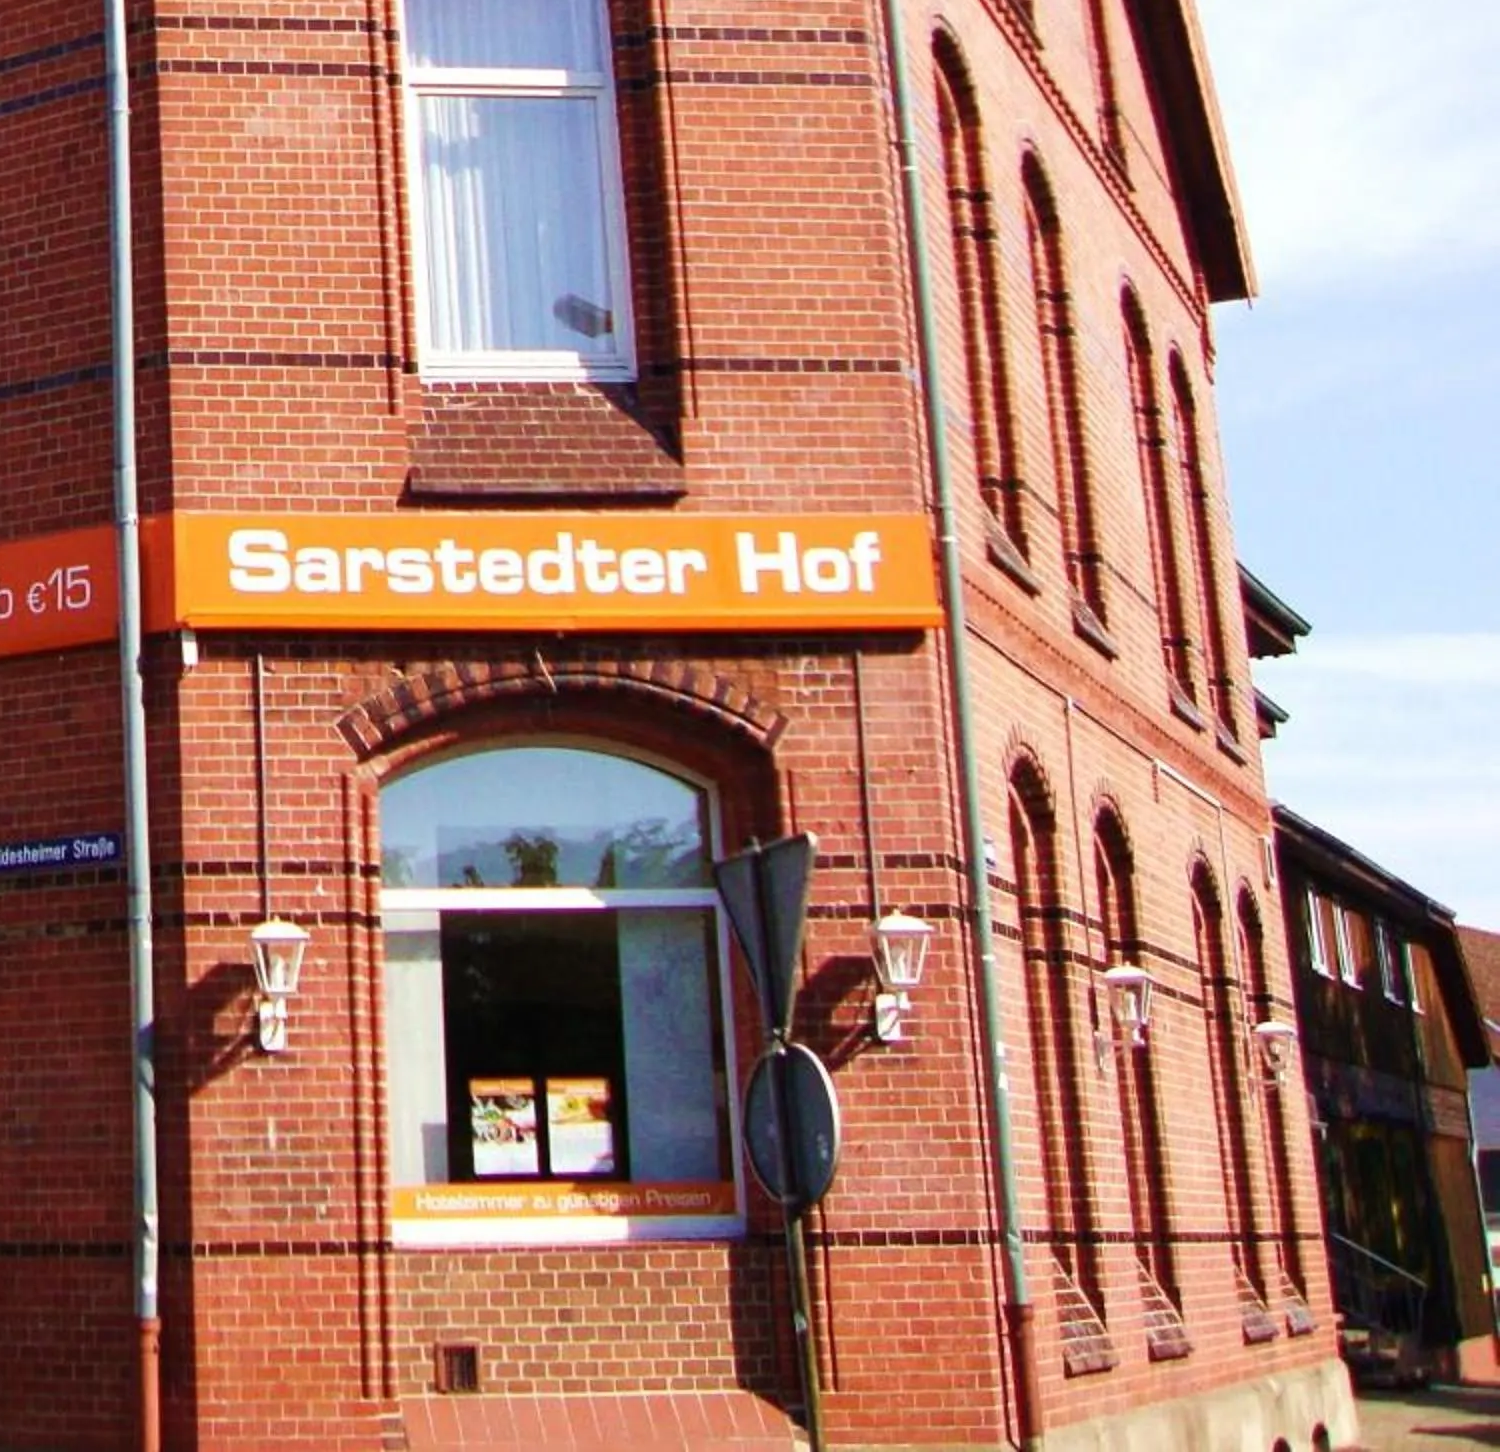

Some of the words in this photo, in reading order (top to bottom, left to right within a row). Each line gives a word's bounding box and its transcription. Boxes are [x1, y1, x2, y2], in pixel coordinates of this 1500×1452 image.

[228, 529, 708, 595] Sarstedter
[735, 531, 882, 594] Hof
[26, 564, 92, 615] €15
[72, 837, 115, 859] Straße
